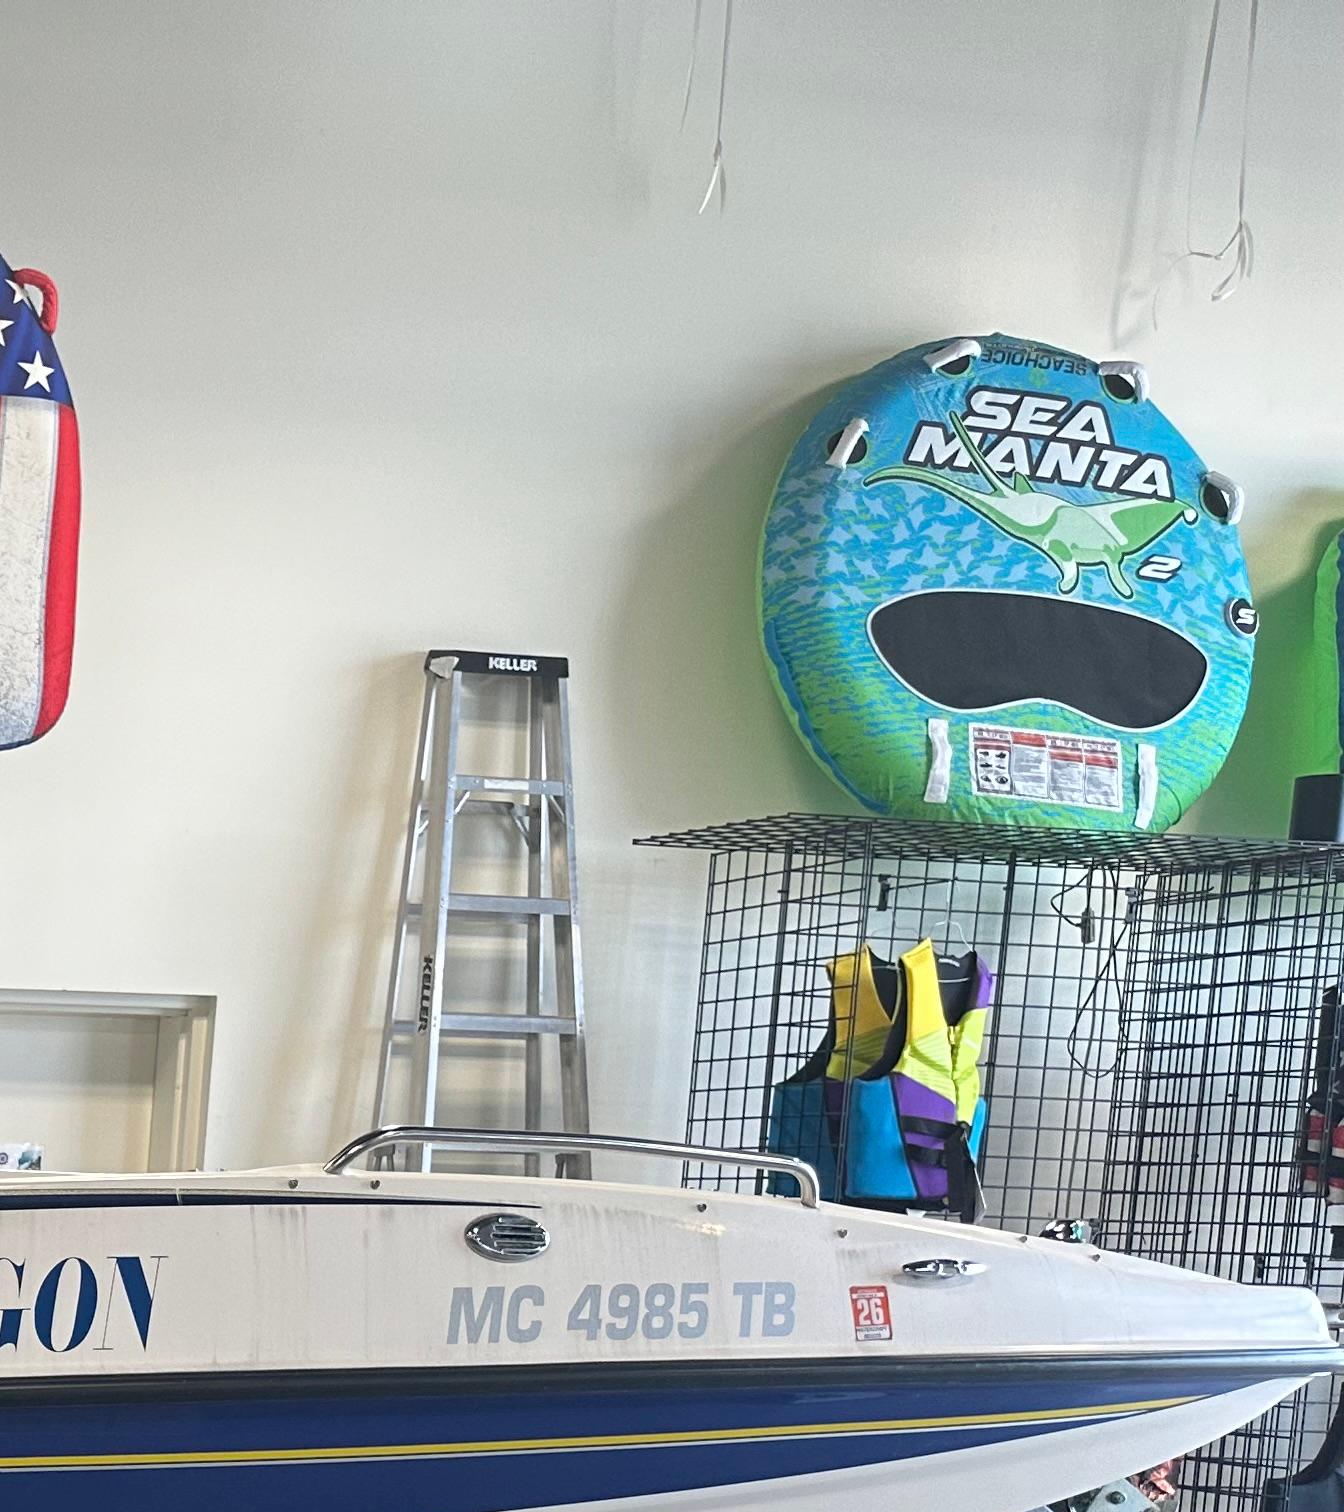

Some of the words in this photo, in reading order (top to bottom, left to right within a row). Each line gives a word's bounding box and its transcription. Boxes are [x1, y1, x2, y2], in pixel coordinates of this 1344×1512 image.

[980, 350, 1088, 376] SEACHOICE
[962, 390, 1111, 445] SEA
[908, 425, 1173, 498] MANTA
[1139, 556, 1181, 580] 2
[488, 656, 538, 672] KELLER
[418, 956, 433, 1032] KELLER
[446, 1285, 545, 1345] MC
[566, 1281, 711, 1344] 4985
[731, 1281, 797, 1338] TB
[856, 1298, 885, 1326] 26
